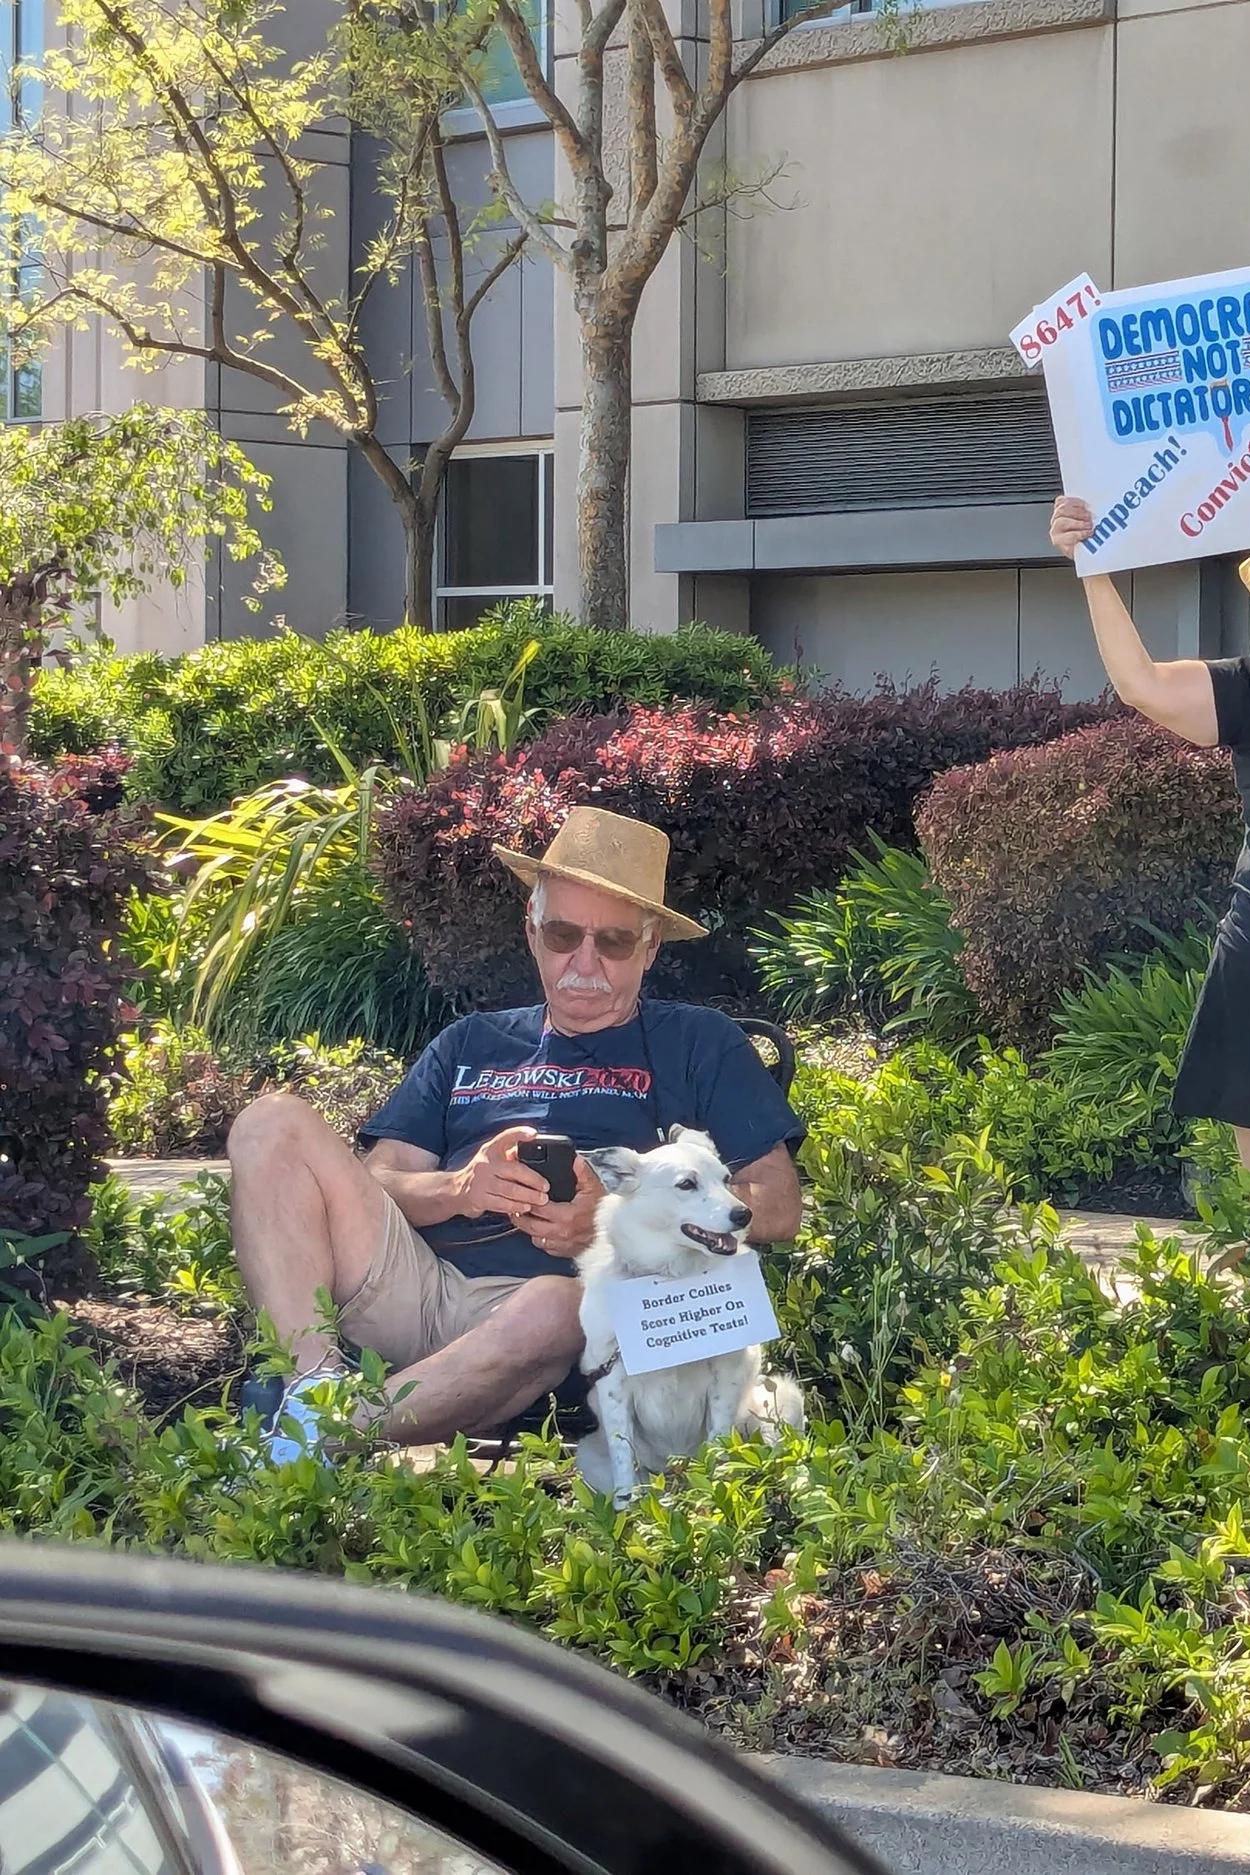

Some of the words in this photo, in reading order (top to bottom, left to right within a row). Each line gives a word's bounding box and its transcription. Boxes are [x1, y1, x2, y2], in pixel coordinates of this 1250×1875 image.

[1020, 285, 1101, 361] 8647!
[1182, 340, 1242, 383] NOT
[452, 1065, 584, 1092] LEBOWSKI
[642, 1292, 685, 1311] Border
[688, 1282, 732, 1300] Collies
[725, 1300, 745, 1311] On
[646, 1328, 707, 1349] Cognitive
